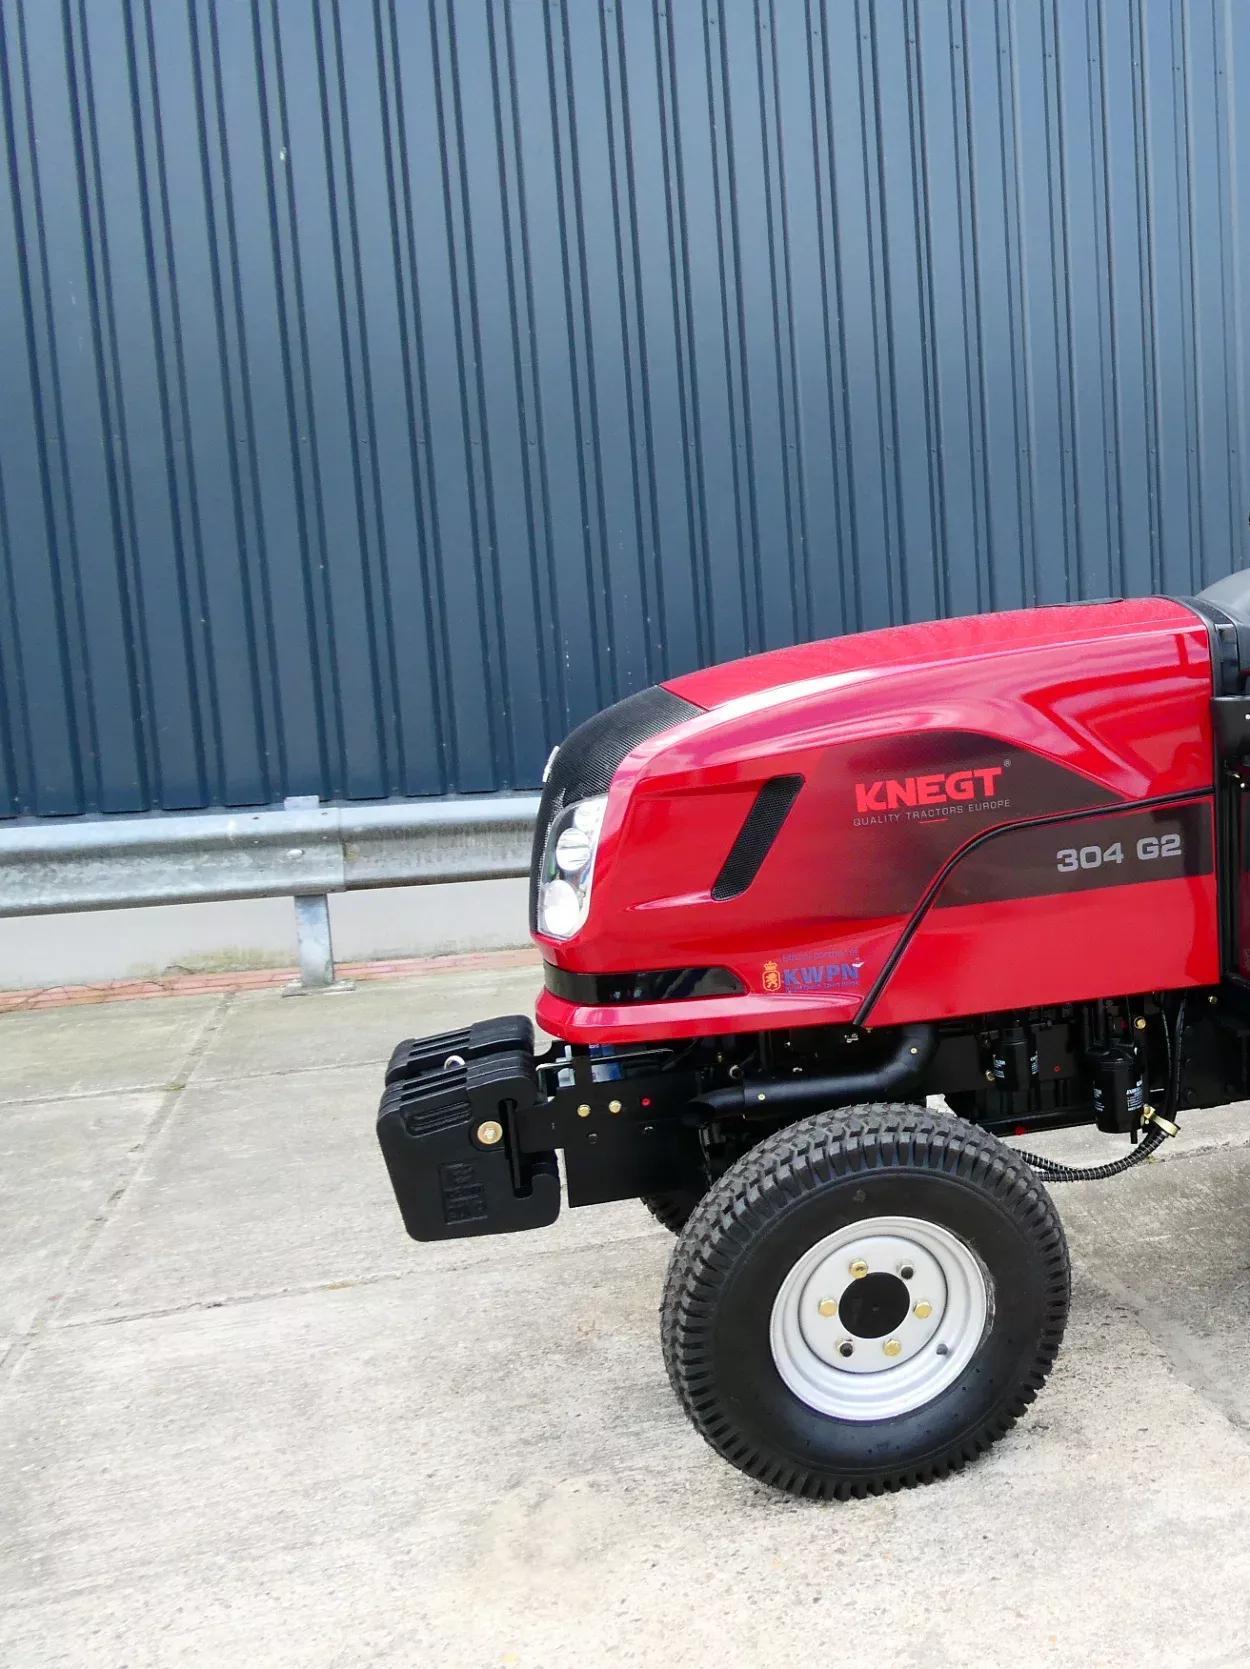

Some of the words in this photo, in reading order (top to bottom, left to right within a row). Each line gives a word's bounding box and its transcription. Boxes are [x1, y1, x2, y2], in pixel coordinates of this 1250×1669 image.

[855, 767, 1002, 813] KNEGT
[853, 813, 901, 827] QUALITY
[906, 805, 964, 820] TRACTORS
[968, 799, 1011, 813] EUROPE
[1056, 842, 1125, 873] 304
[1136, 833, 1182, 861] G2
[783, 962, 859, 986] KWPN
